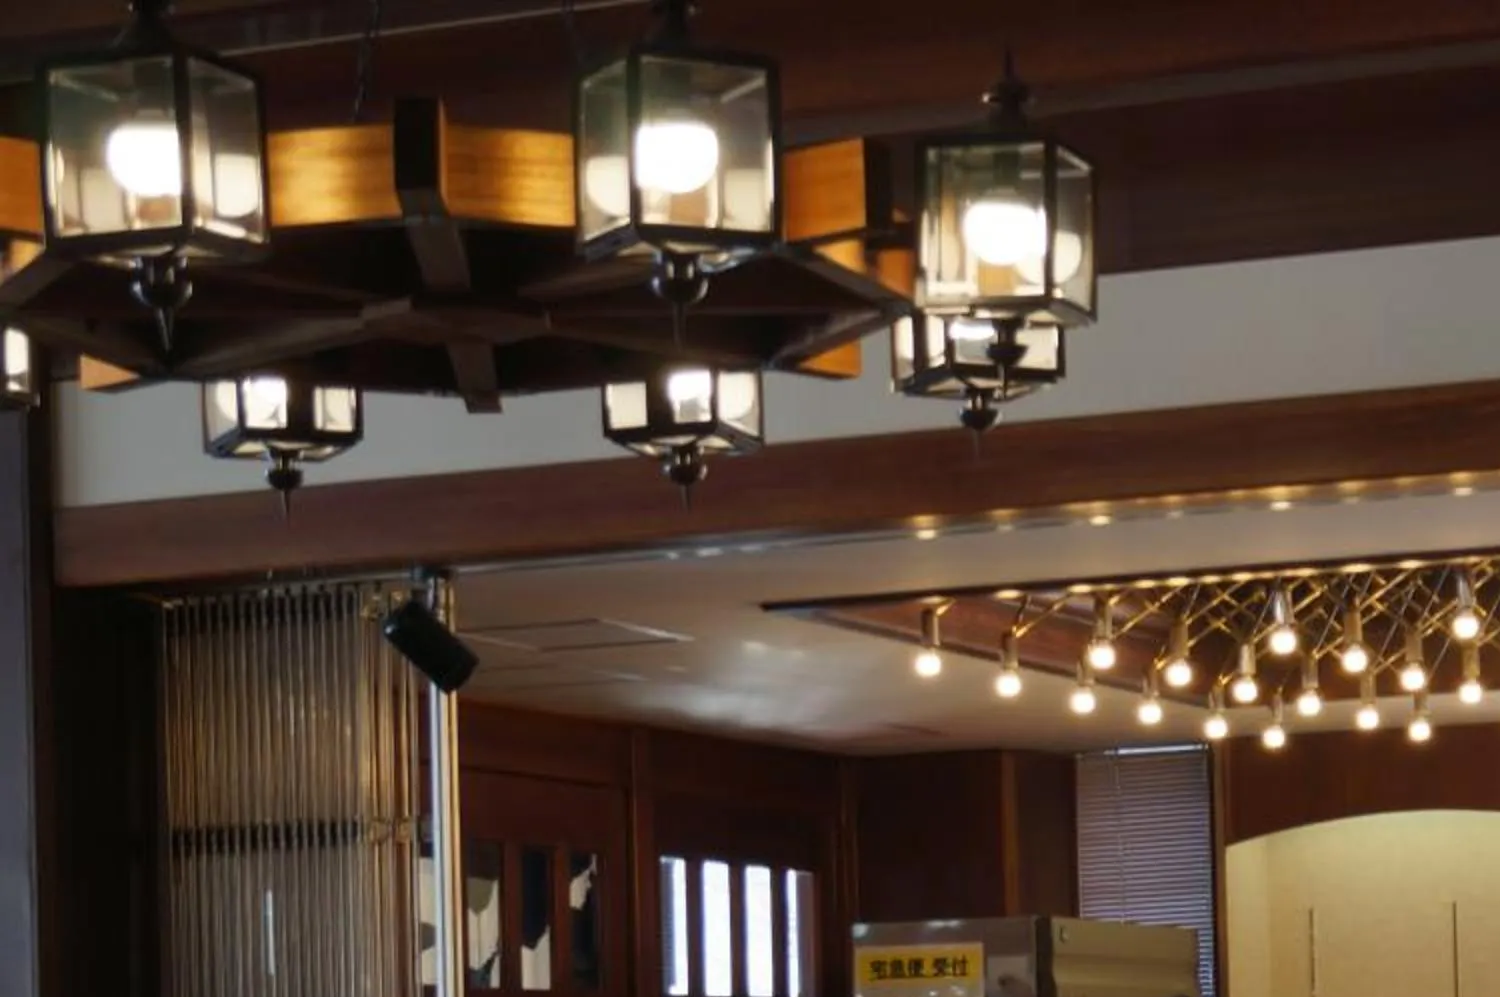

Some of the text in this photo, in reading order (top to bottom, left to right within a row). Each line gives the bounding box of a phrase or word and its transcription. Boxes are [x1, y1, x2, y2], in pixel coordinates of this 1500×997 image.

[869, 954, 969, 980] 宅急便 受付
